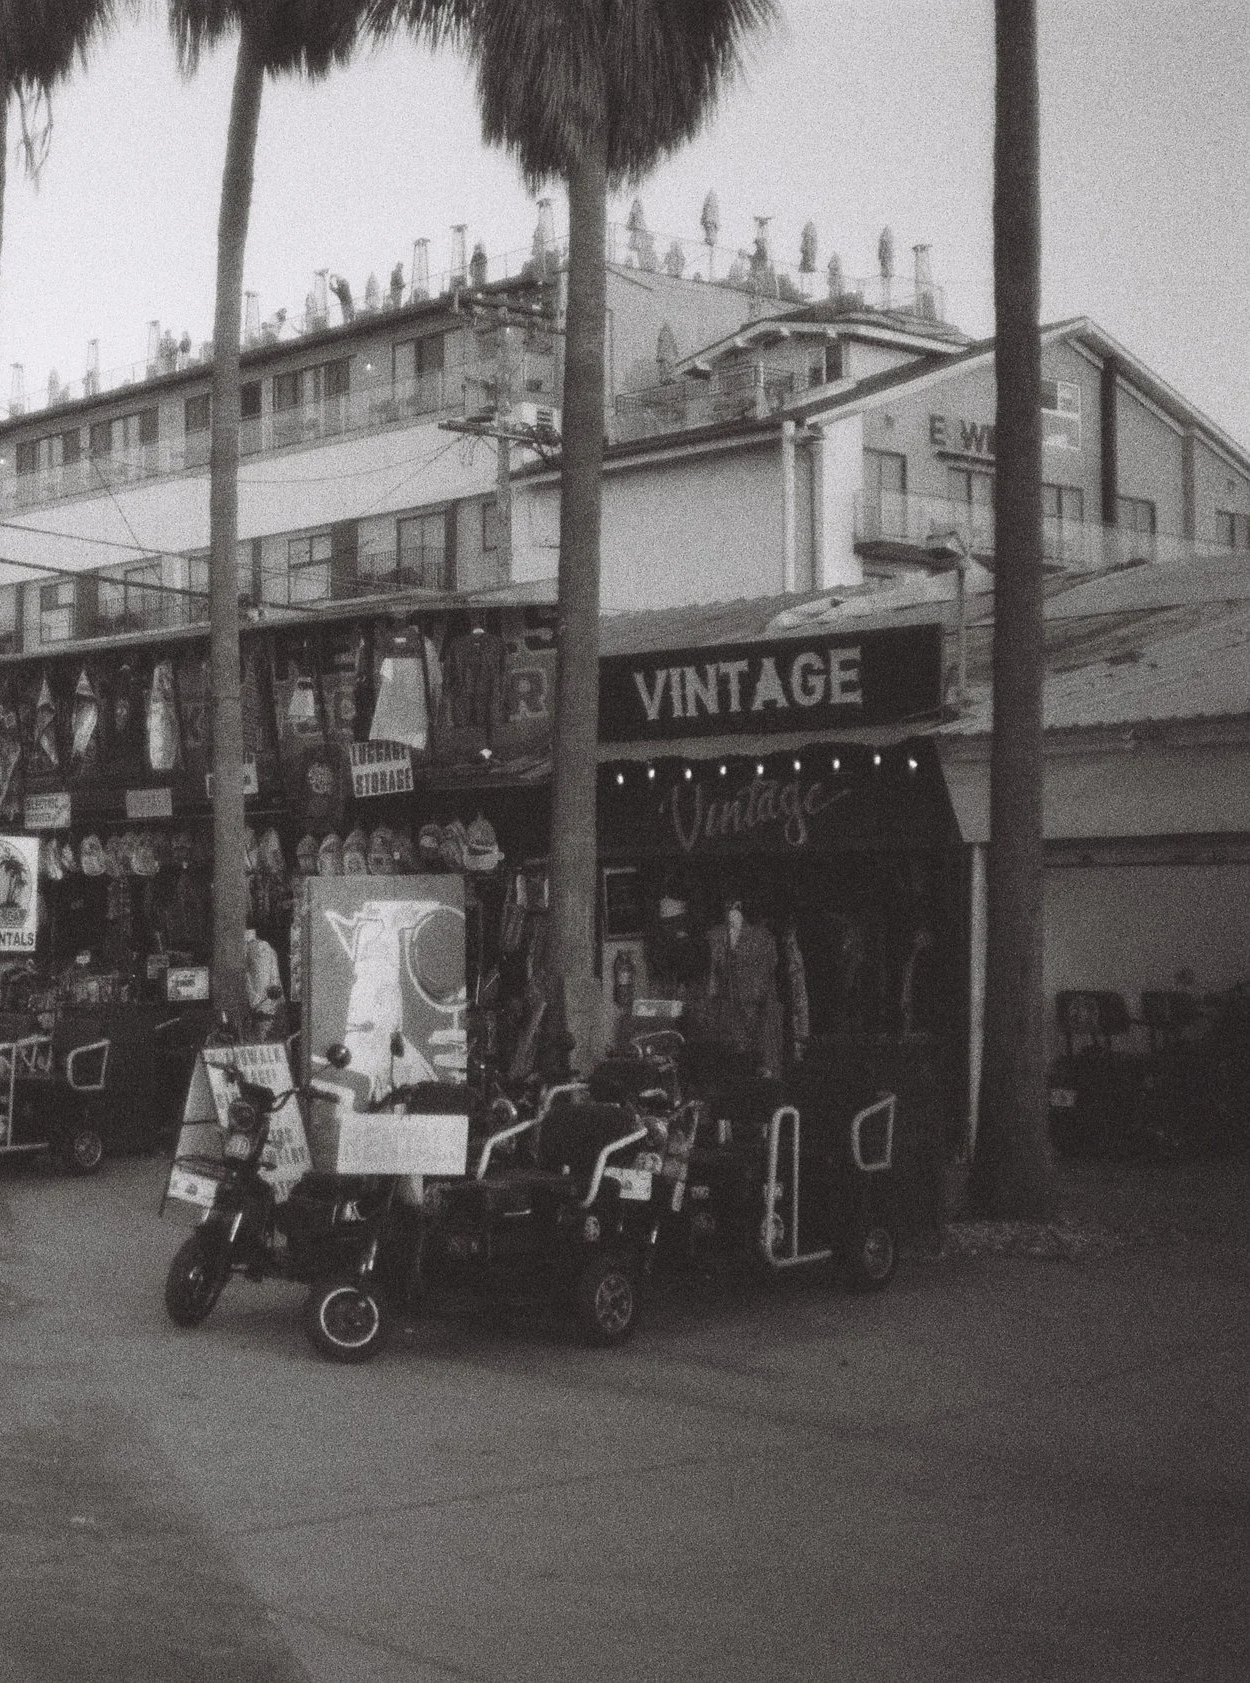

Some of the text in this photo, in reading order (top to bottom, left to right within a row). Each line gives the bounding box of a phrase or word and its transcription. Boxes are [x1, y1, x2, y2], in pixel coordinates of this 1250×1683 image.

[633, 646, 863, 720] VINTAGE
[355, 768, 411, 795] STORAGE
[659, 777, 852, 851] Vintage
